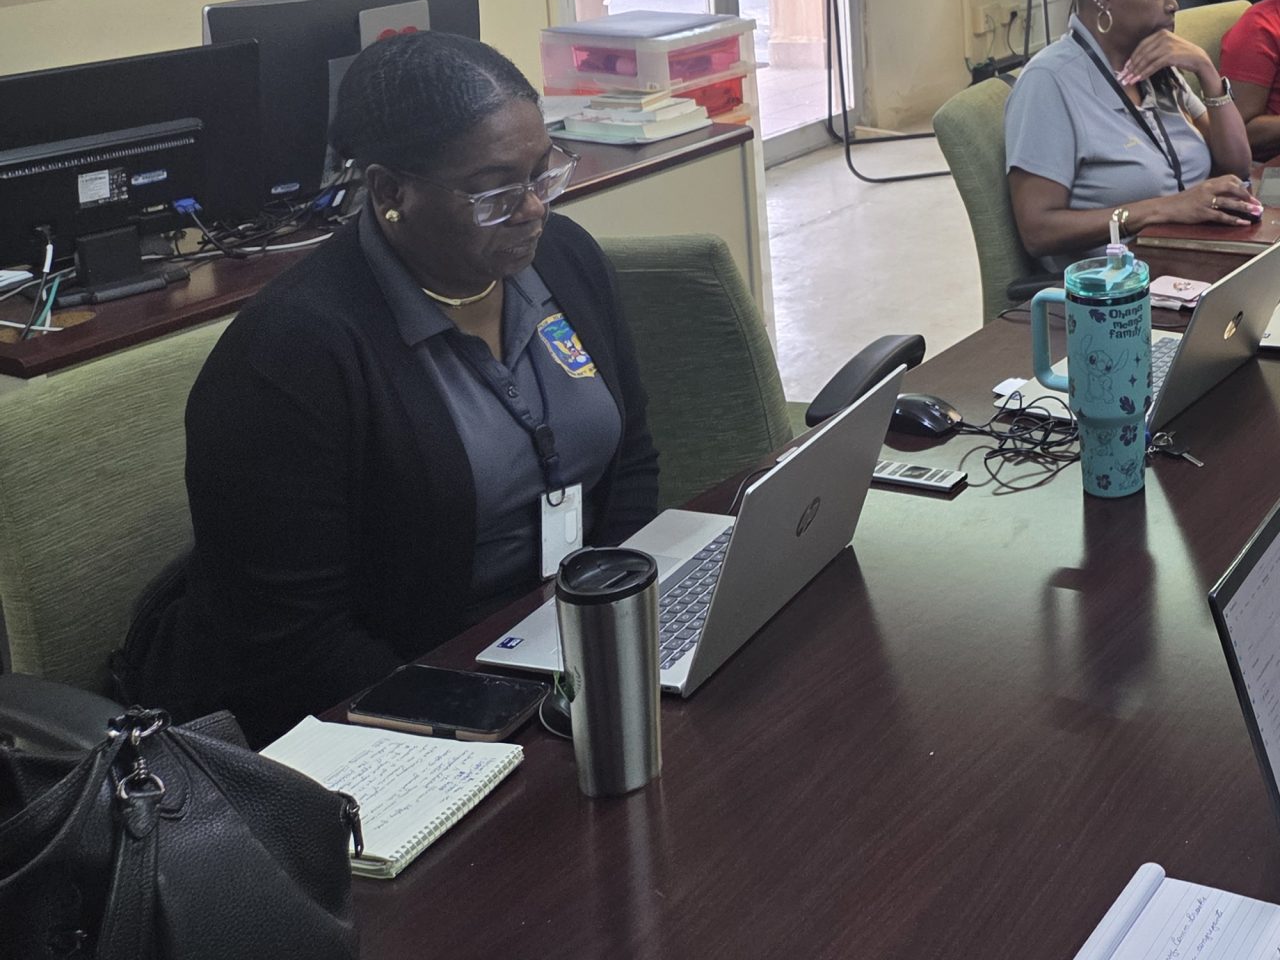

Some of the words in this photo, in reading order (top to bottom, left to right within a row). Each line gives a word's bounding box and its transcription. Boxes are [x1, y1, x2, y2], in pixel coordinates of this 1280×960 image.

[1109, 304, 1143, 319] Ohana
[1113, 314, 1143, 329] means
[1109, 326, 1142, 339] family
